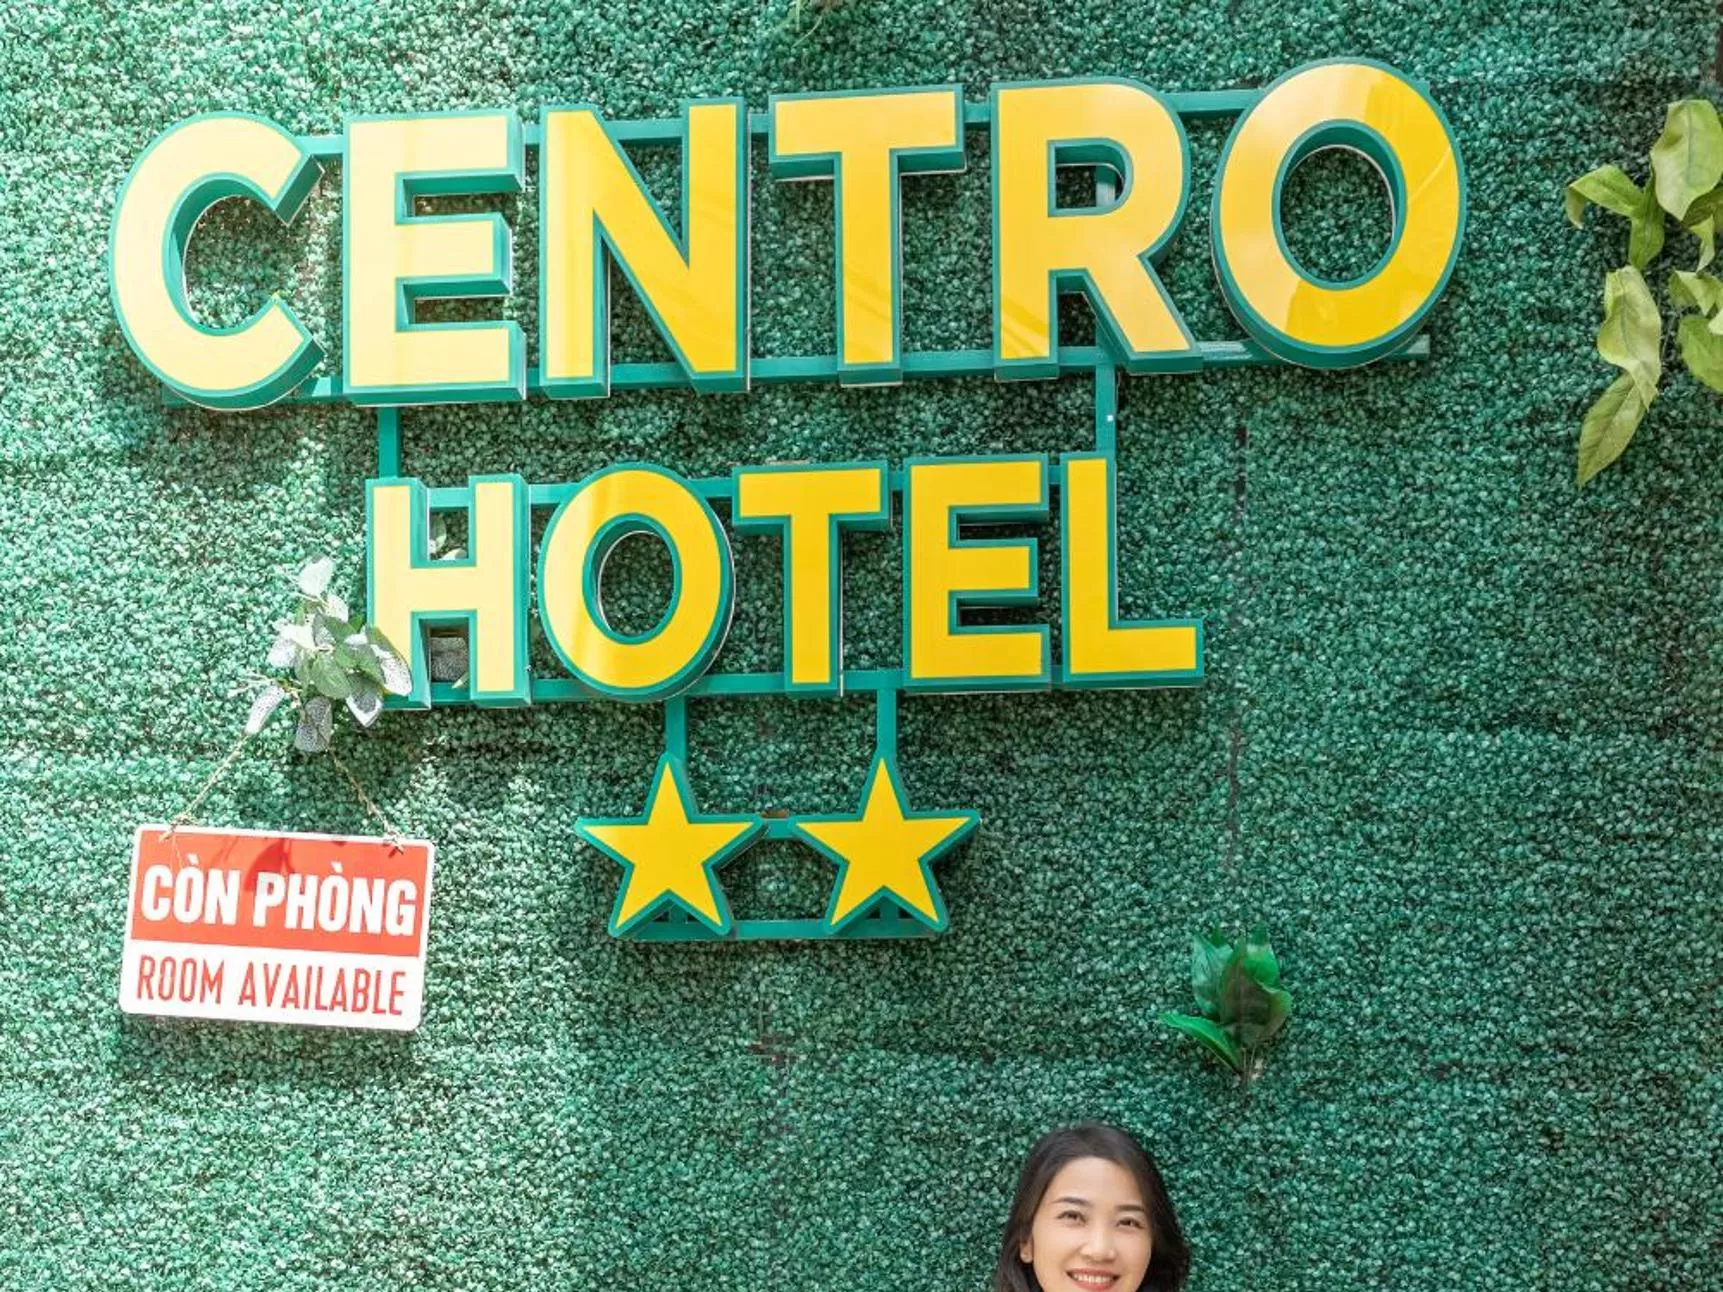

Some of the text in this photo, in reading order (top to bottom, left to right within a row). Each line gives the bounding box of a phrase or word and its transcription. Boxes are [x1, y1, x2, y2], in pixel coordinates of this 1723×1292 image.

[109, 57, 1467, 409] CENTRO
[366, 453, 1204, 707] HOTEL
[140, 853, 418, 937] CÒN PHÒNG
[136, 954, 406, 1017] ROOM AVAILABLE
